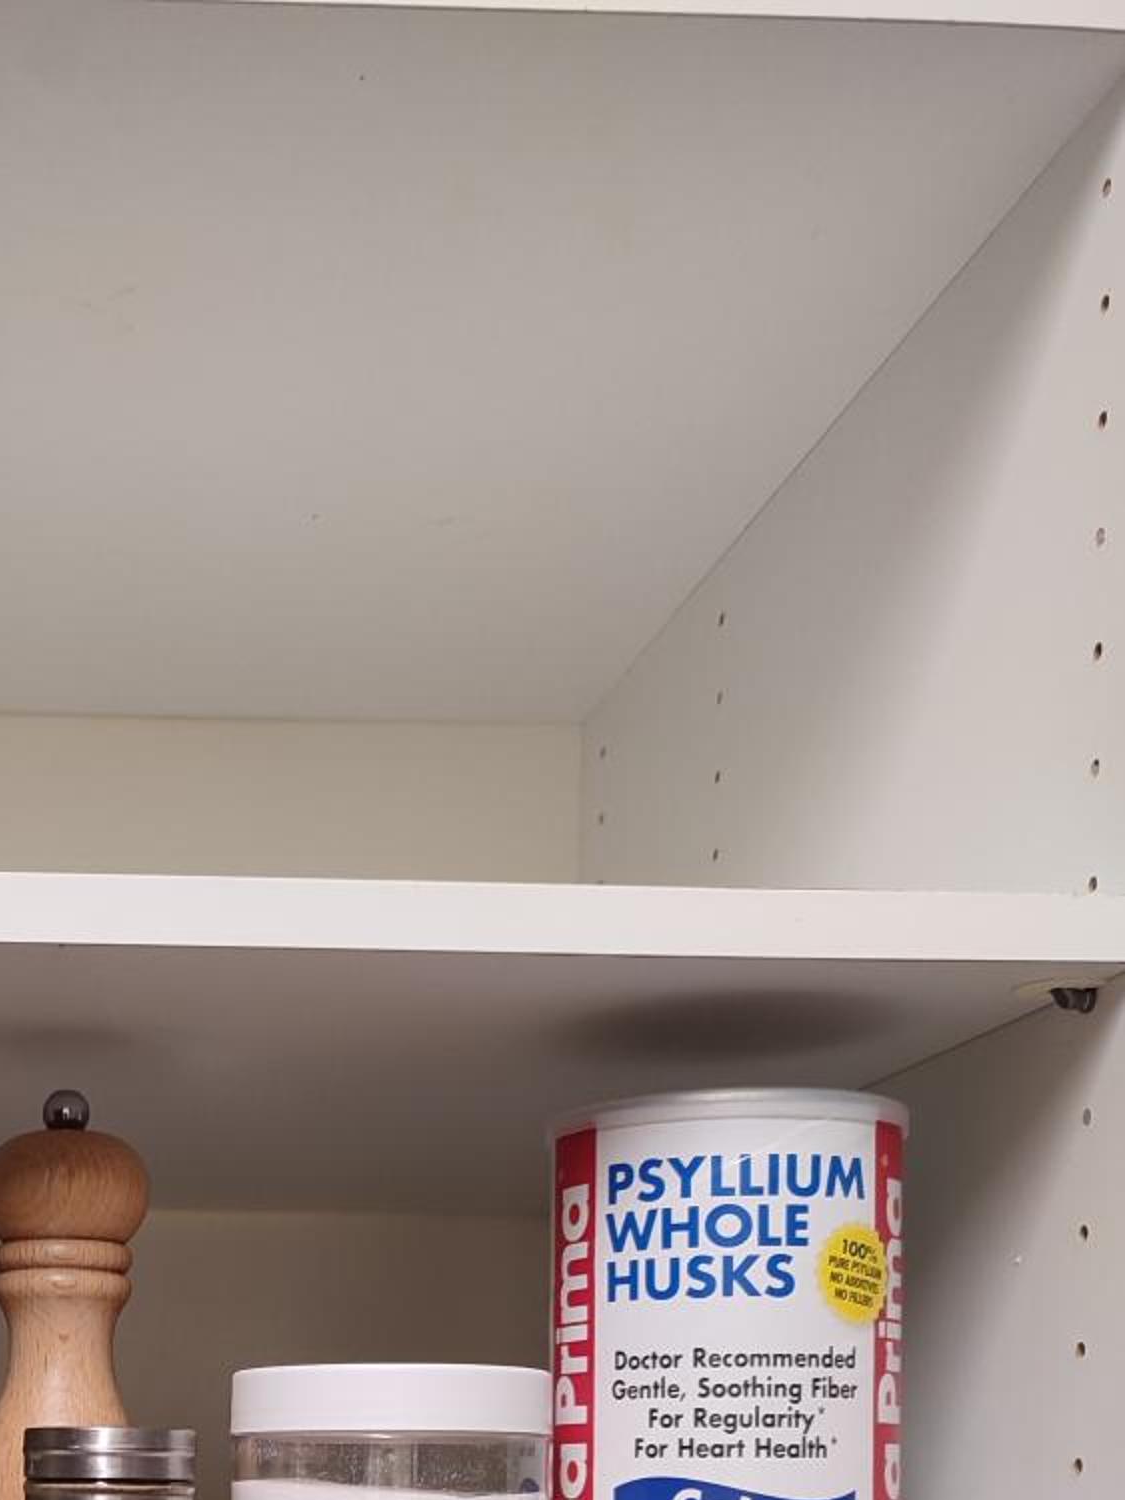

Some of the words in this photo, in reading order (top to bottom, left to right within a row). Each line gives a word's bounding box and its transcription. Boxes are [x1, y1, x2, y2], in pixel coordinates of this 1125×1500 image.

[607, 1153, 865, 1204] PSYLLIUM
[605, 1203, 810, 1253] WHOLE
[606, 1253, 796, 1302] HUSKS
[876, 1176, 902, 1426] Prima
[555, 1183, 590, 1426] Prima
[613, 1350, 684, 1371] Doctor
[692, 1346, 857, 1370] Recommended
[611, 1376, 686, 1401] Gentle,
[697, 1375, 803, 1404] Soothing
[811, 1375, 858, 1400] Fiber
[648, 1407, 684, 1429] For
[634, 1437, 669, 1459] For
[677, 1437, 746, 1459] Heart
